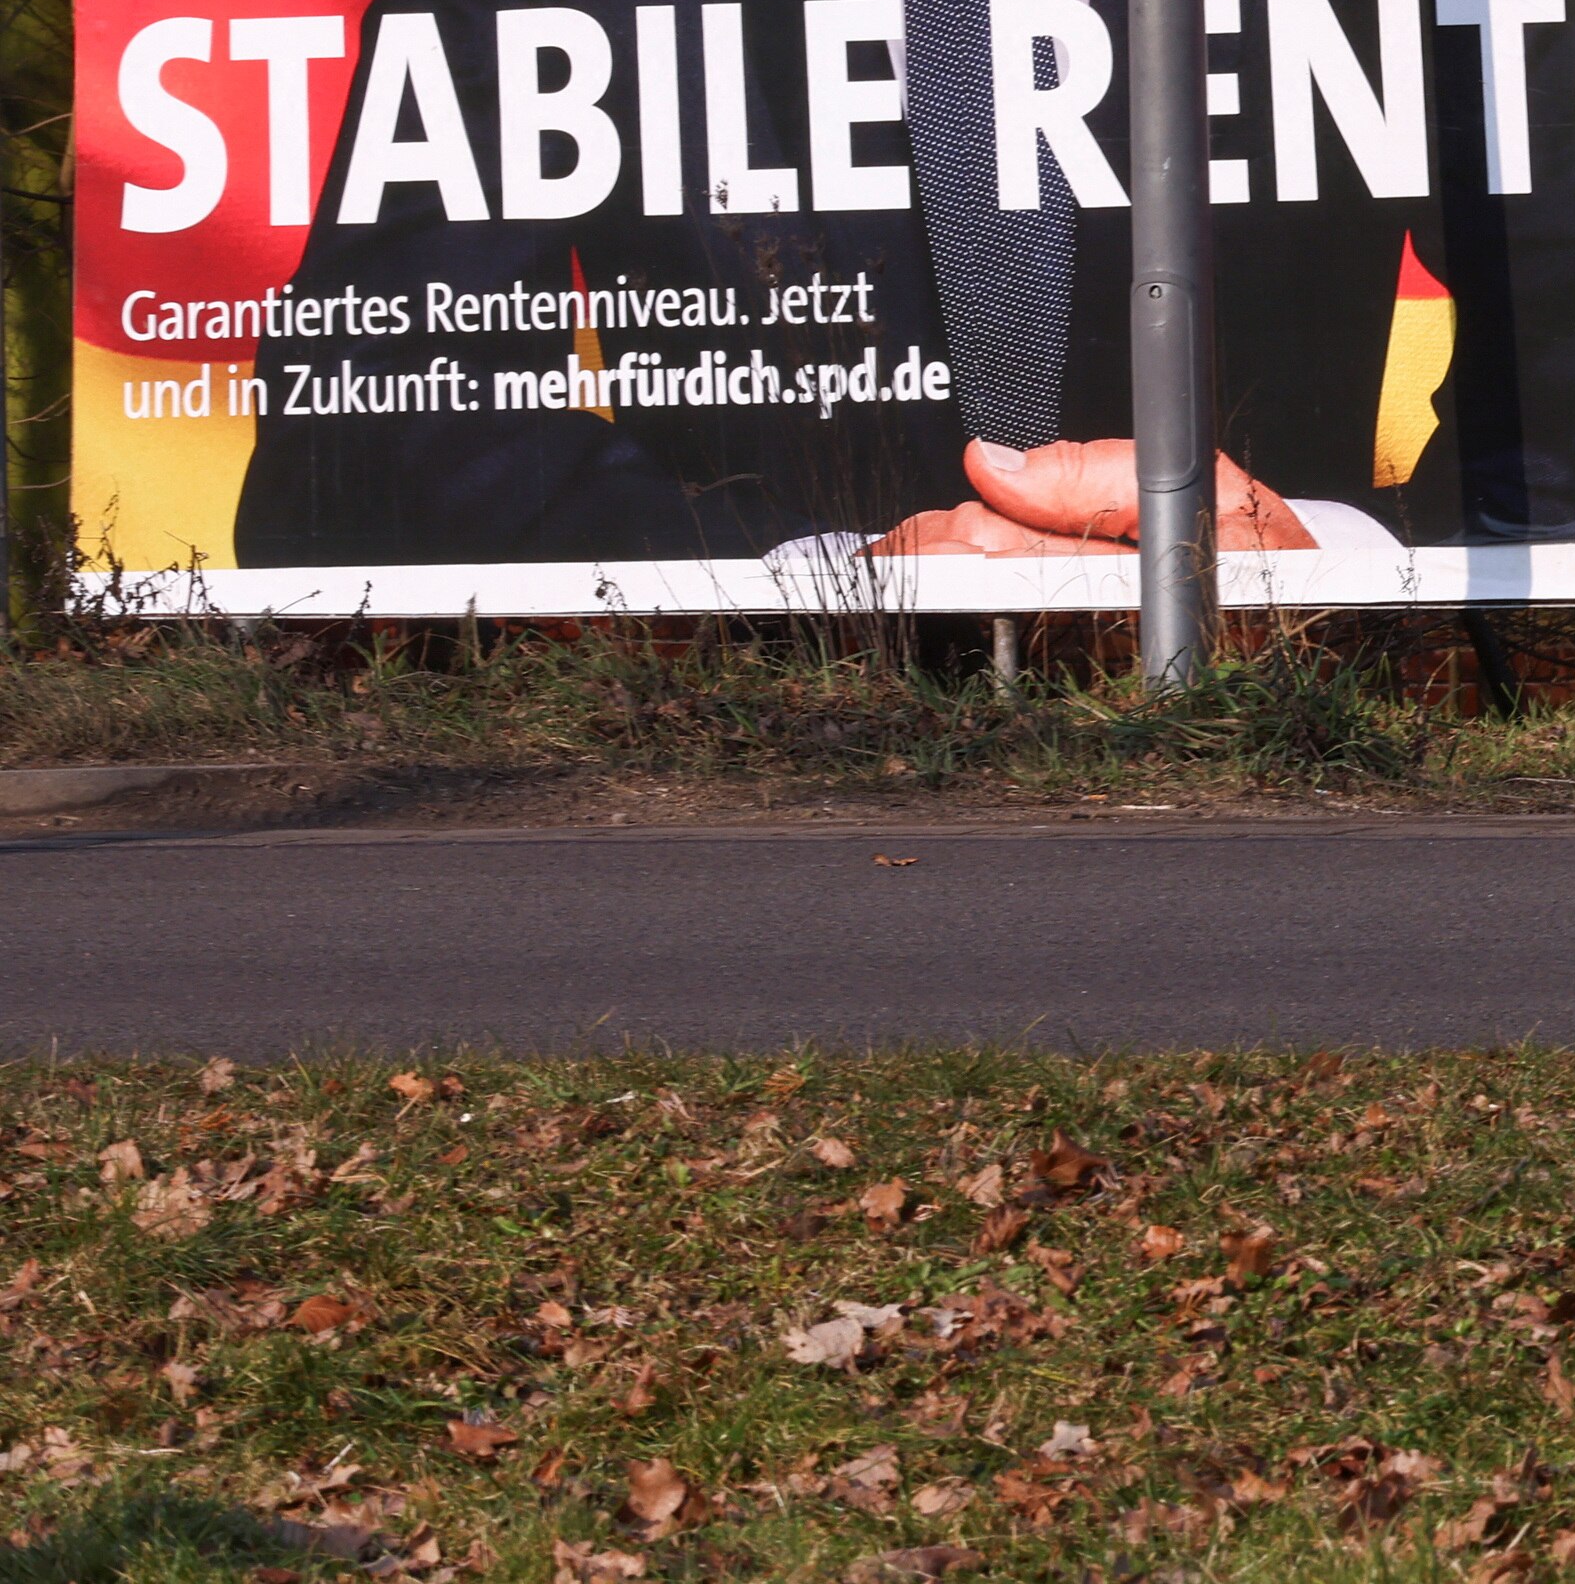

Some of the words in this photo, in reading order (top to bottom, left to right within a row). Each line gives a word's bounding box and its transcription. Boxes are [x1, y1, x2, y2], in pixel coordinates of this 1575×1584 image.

[121, 282, 412, 343] Garantiertes
[426, 274, 749, 336] Rentenniveau.
[761, 271, 877, 329] Jetzt
[122, 362, 212, 419] und
[227, 360, 268, 417] in
[282, 358, 480, 416] Zukunft:
[494, 344, 952, 420] mehrfürdich.spd.de
